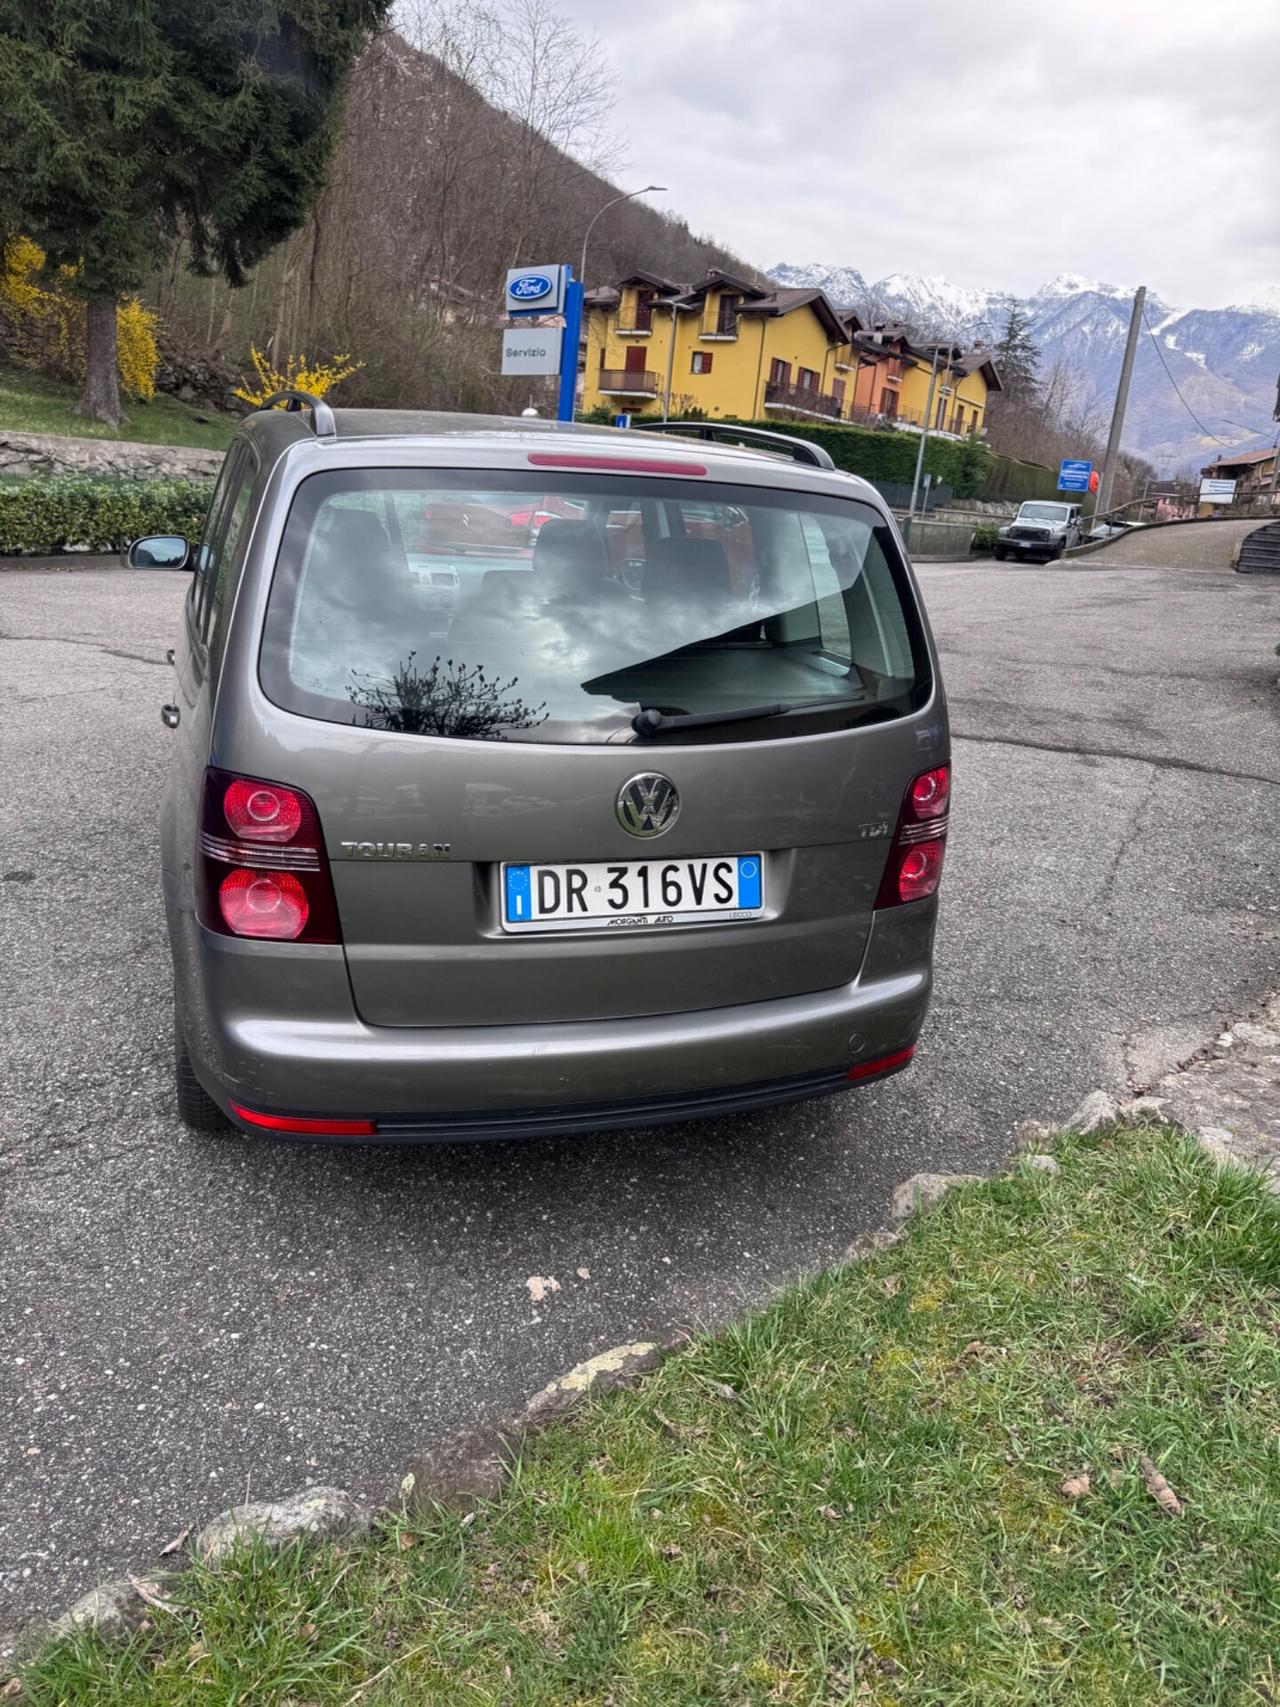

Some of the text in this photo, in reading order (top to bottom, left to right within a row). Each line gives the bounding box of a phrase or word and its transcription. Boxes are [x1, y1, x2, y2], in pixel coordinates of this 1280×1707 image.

[515, 279, 543, 295] Ford
[505, 348, 547, 358] Servizio
[340, 841, 451, 858] TOURAN
[537, 862, 733, 914] DR 316VS
[606, 915, 674, 926] MORGANTI AUTO
